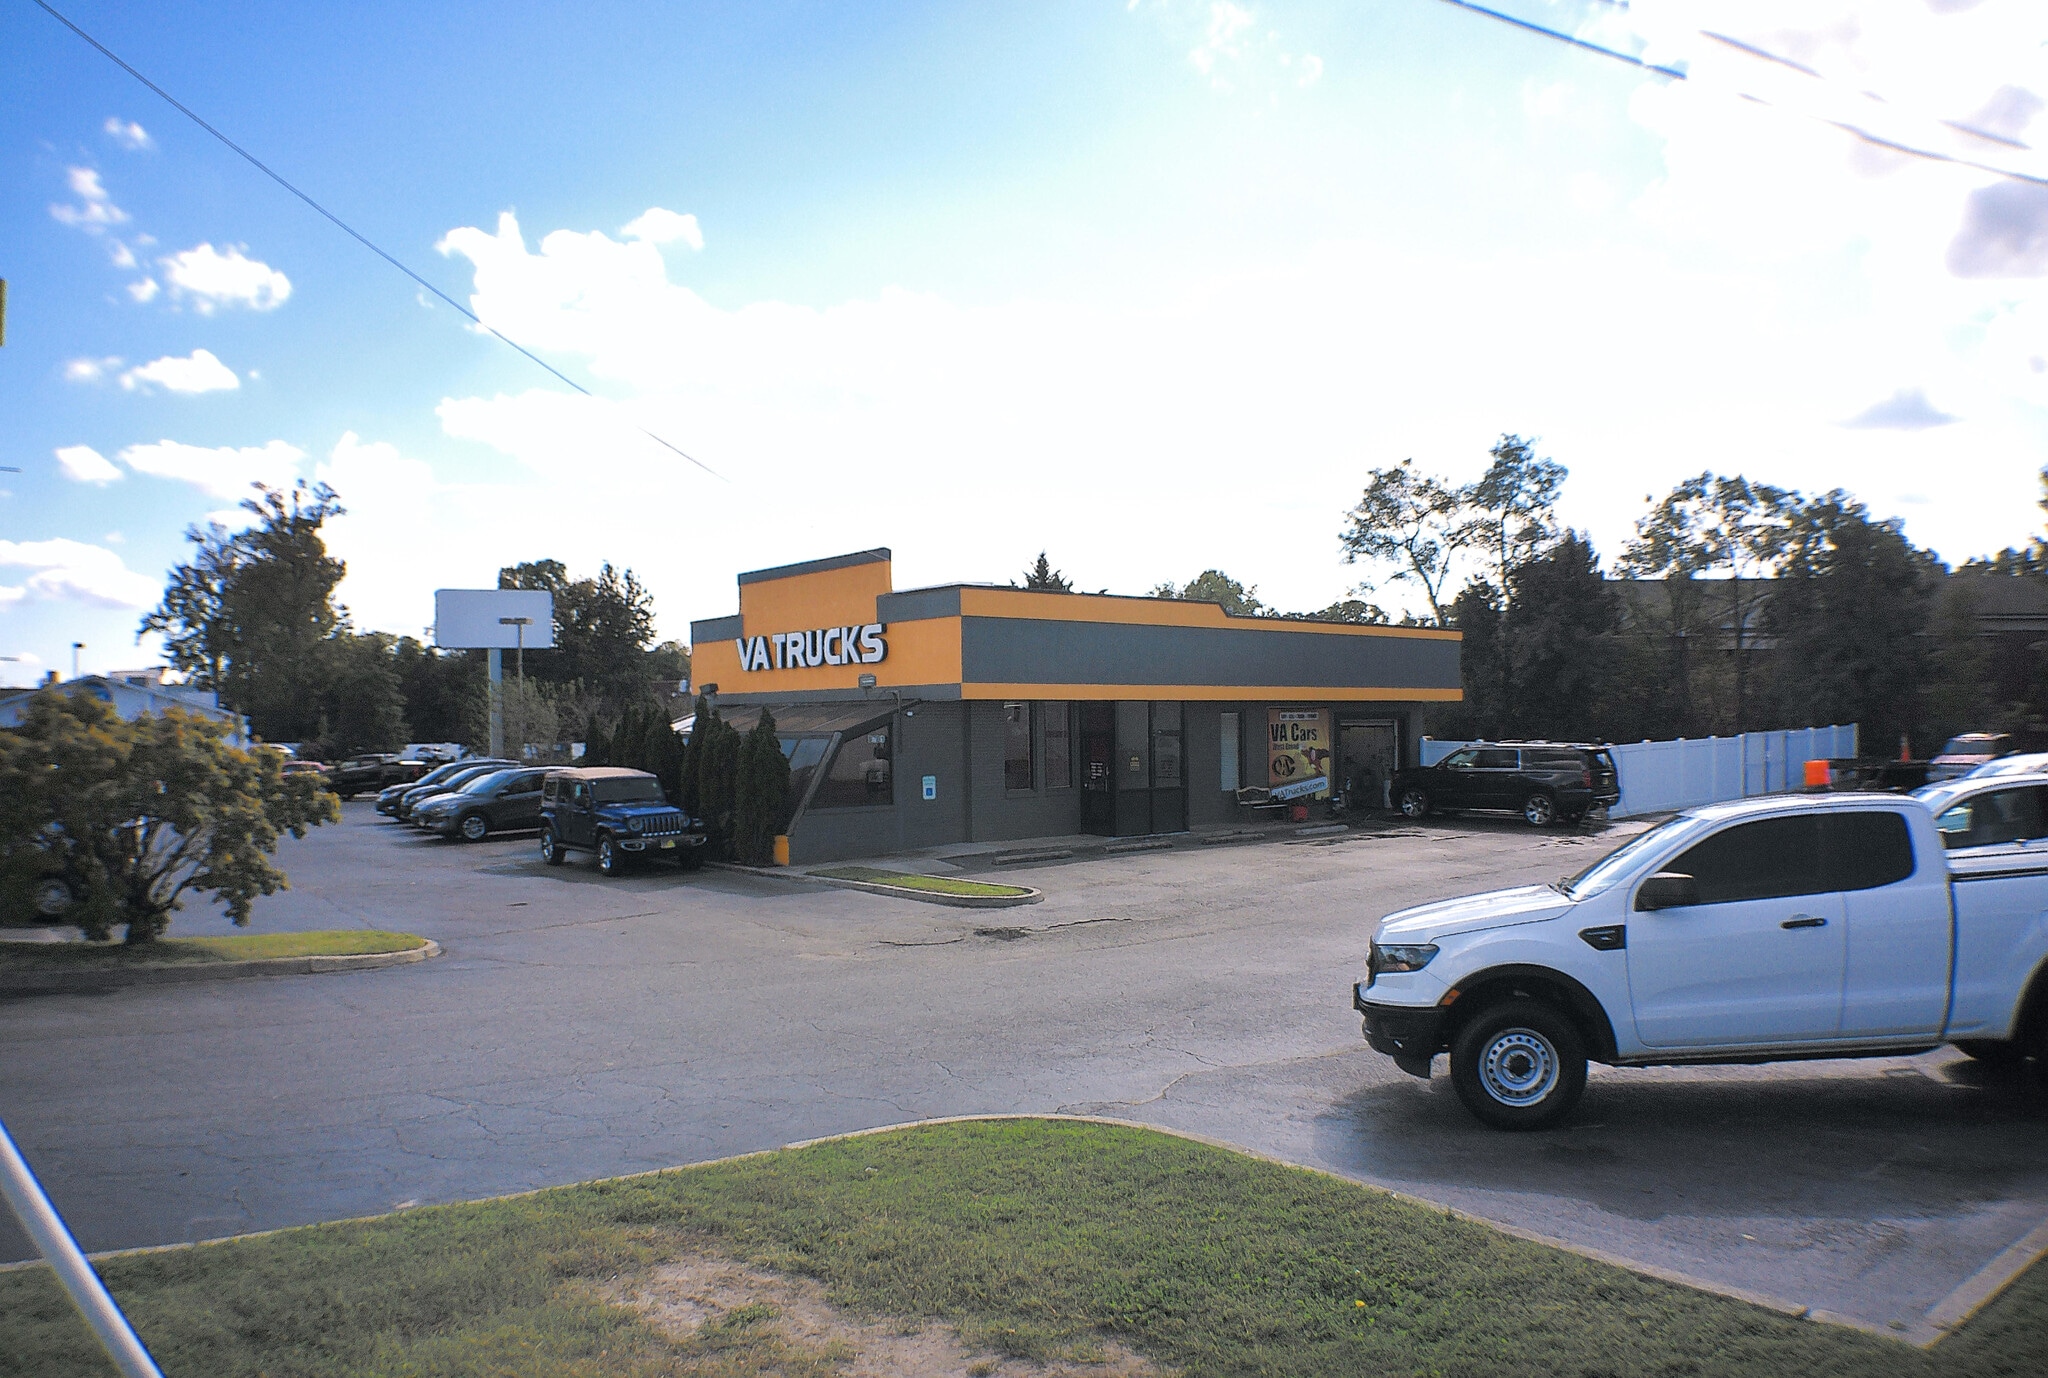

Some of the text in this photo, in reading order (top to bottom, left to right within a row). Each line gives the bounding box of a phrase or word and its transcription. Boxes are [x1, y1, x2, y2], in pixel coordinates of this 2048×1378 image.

[736, 622, 888, 671] VA TRUCKS
[1270, 723, 1317, 741] VA Cars
